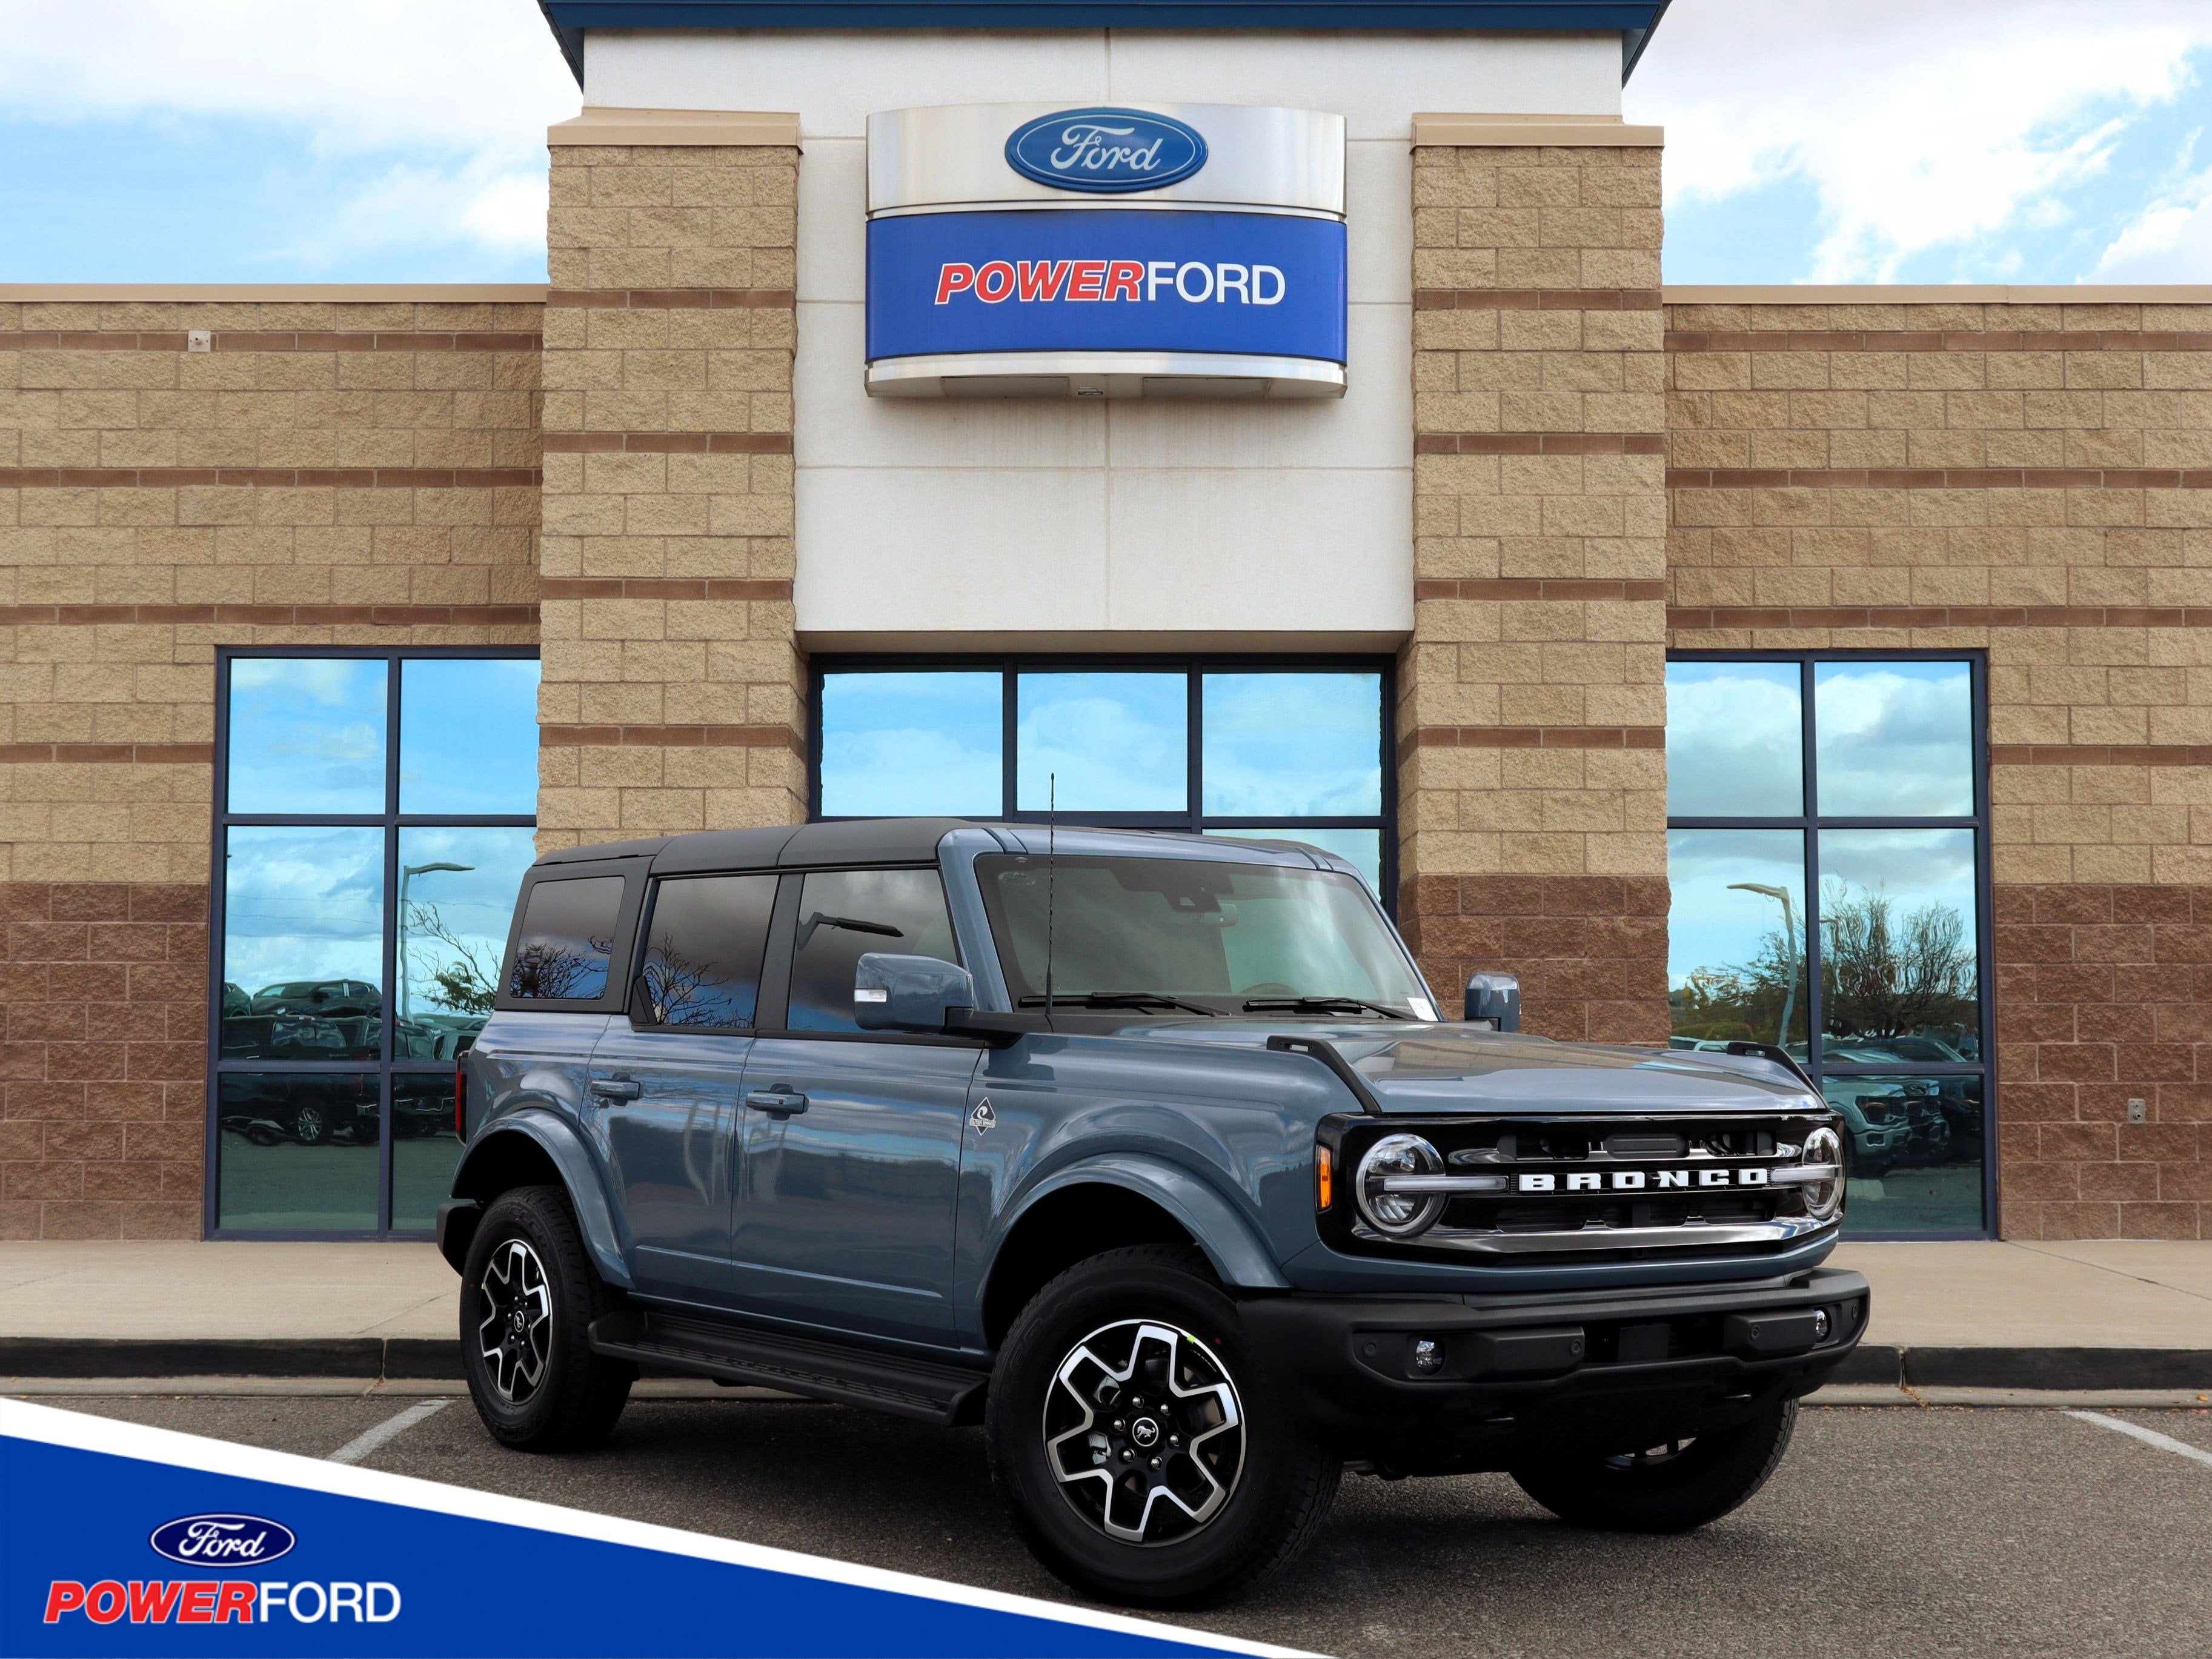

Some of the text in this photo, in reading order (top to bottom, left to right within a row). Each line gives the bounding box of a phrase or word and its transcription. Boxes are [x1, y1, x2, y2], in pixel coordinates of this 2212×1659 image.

[1051, 124, 1163, 171] Ford
[935, 260, 1286, 305] POWERFORD
[1519, 1169, 1768, 1192] BRONCO
